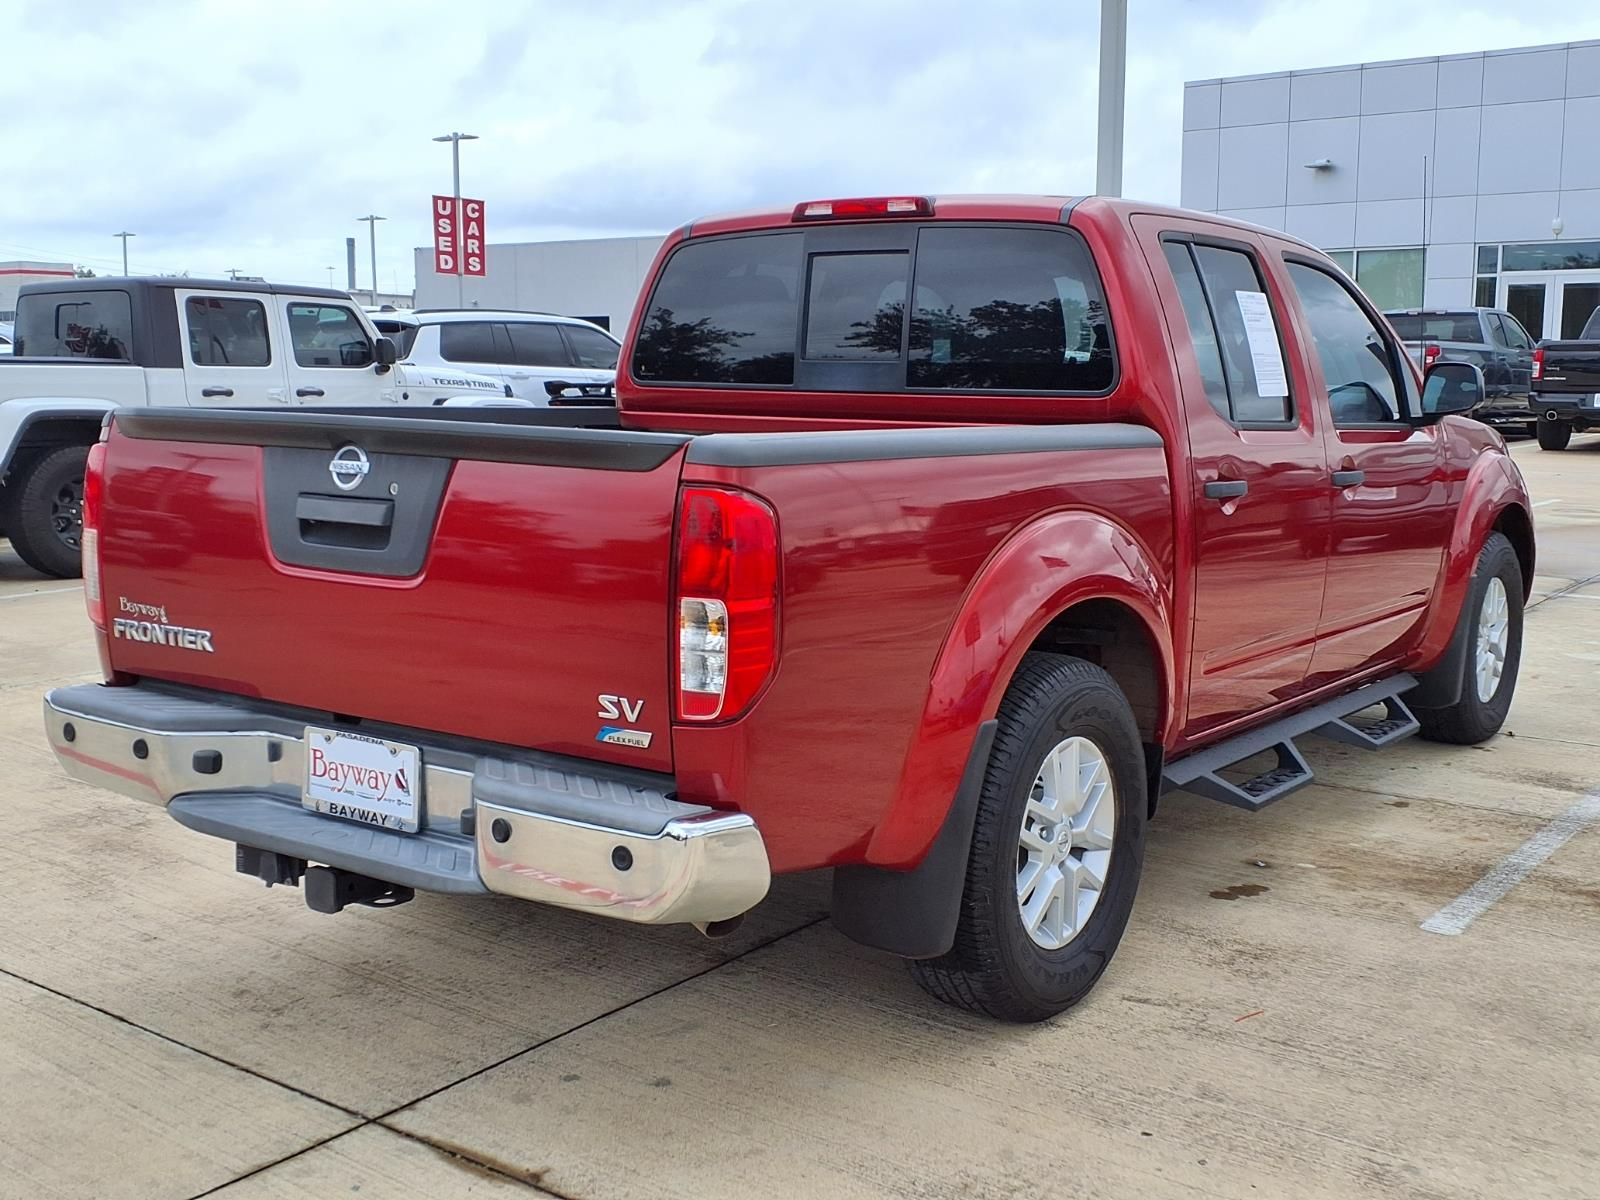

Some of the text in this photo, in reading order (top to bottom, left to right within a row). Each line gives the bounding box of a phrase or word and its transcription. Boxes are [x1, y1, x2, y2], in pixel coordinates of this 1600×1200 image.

[437, 199, 454, 270] USED
[466, 203, 481, 271] CARS
[432, 377, 498, 389] TEXAS TRAIL
[332, 462, 363, 472] NISSAN
[119, 596, 162, 621] Bayway
[113, 617, 214, 652] FRONTIER
[598, 694, 644, 723] SV
[336, 731, 385, 746] PASADENA
[608, 735, 647, 747] FLEX FUEL
[311, 748, 392, 802] Bayway
[329, 803, 389, 825] BAYWAY
